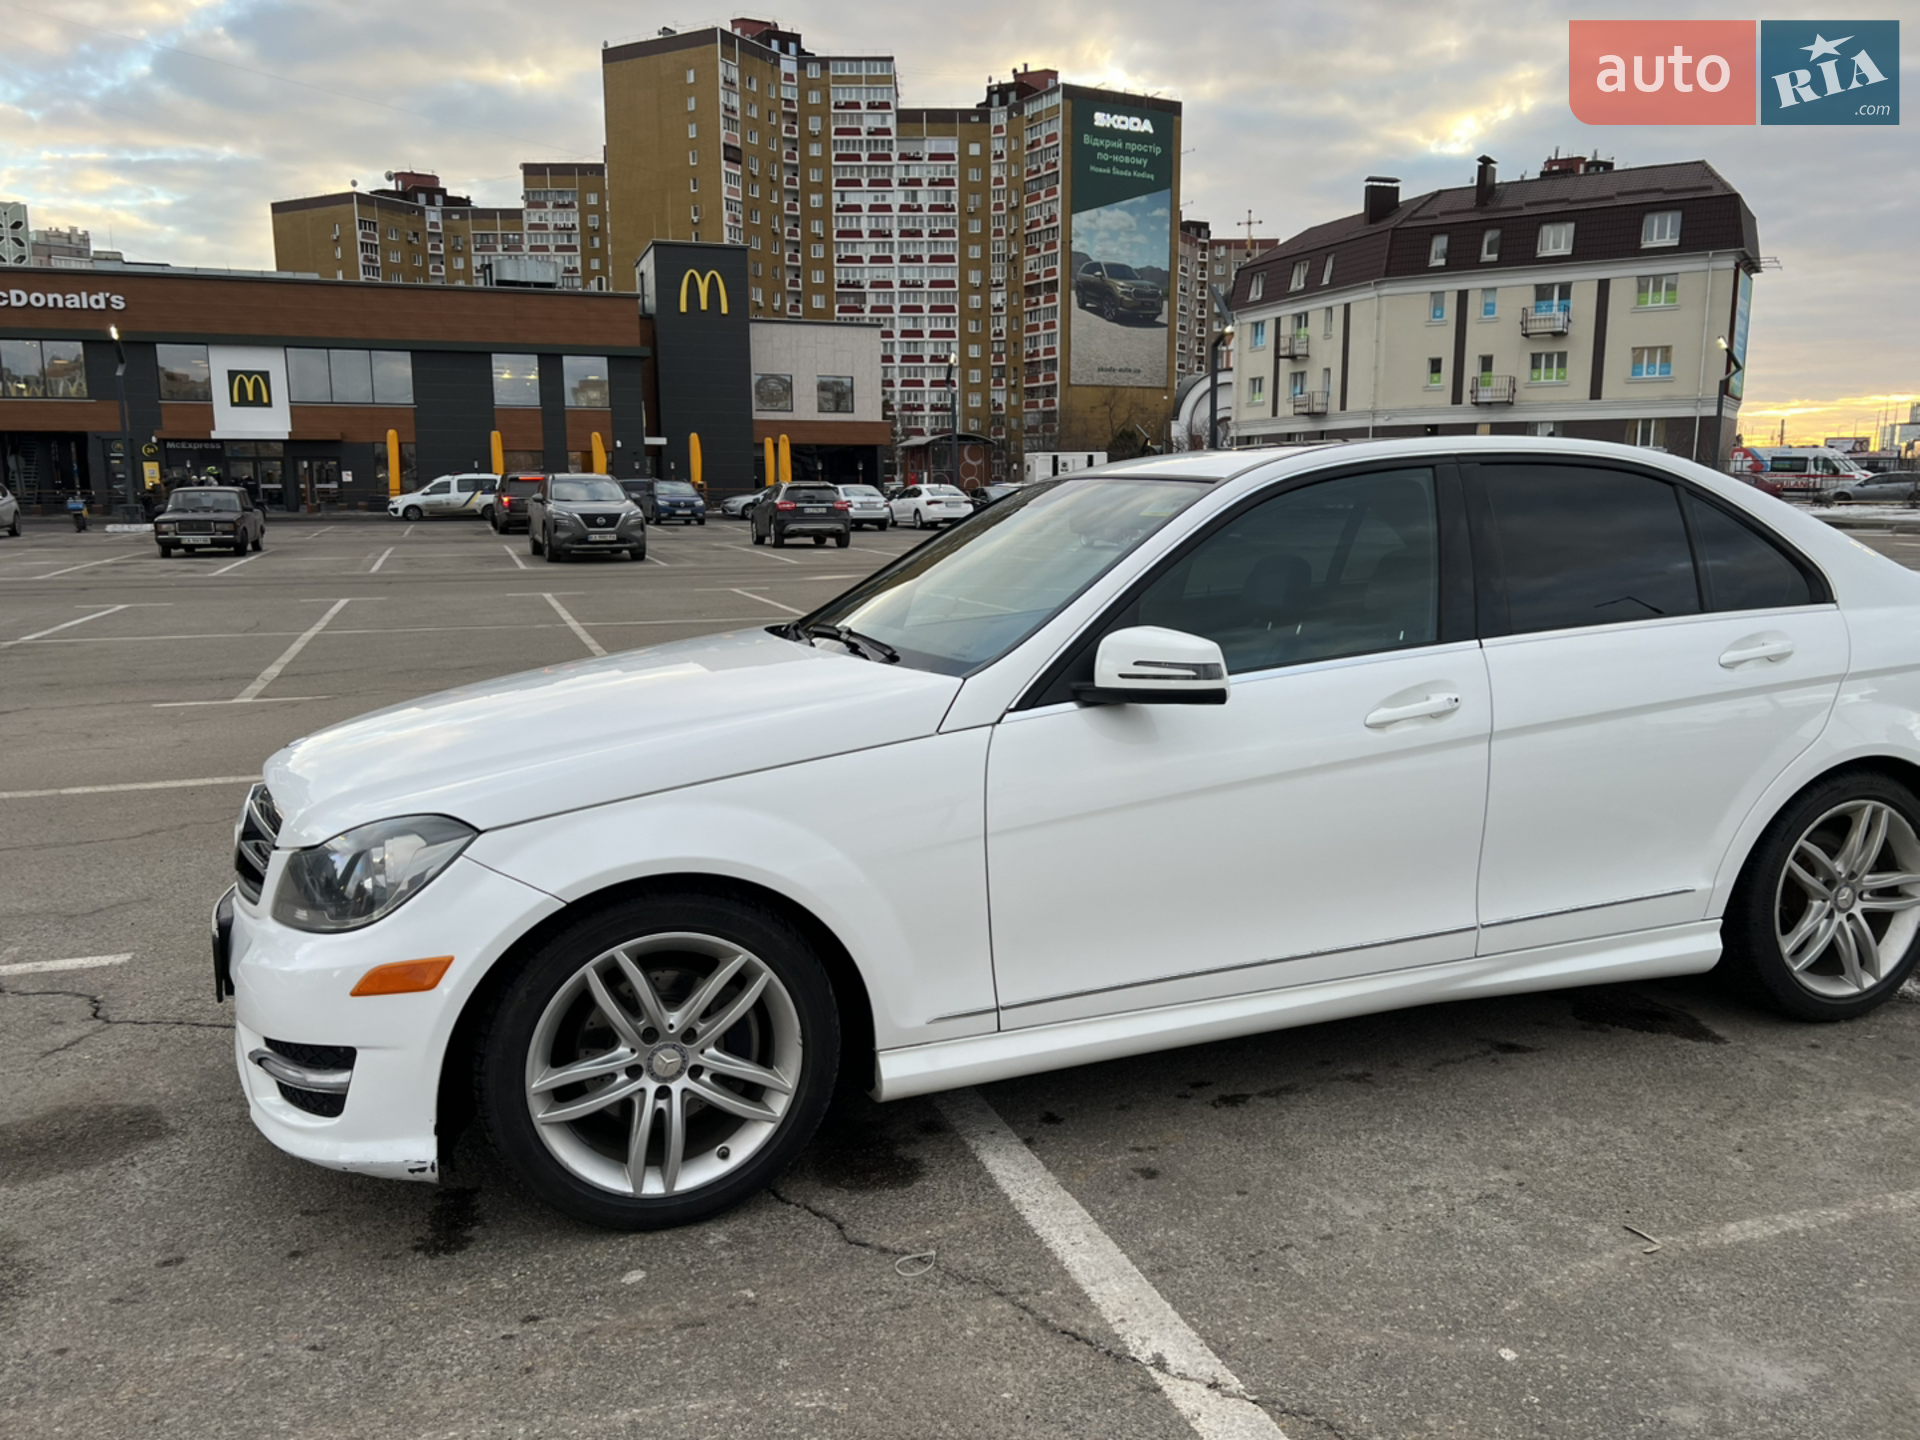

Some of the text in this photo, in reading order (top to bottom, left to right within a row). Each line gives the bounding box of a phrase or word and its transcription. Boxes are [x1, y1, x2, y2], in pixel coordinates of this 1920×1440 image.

[1083, 134, 1162, 156] Відкрий простір
[1096, 152, 1148, 168] по-новому
[0, 289, 126, 310] cDonald's
[166, 441, 221, 450] McExpress
